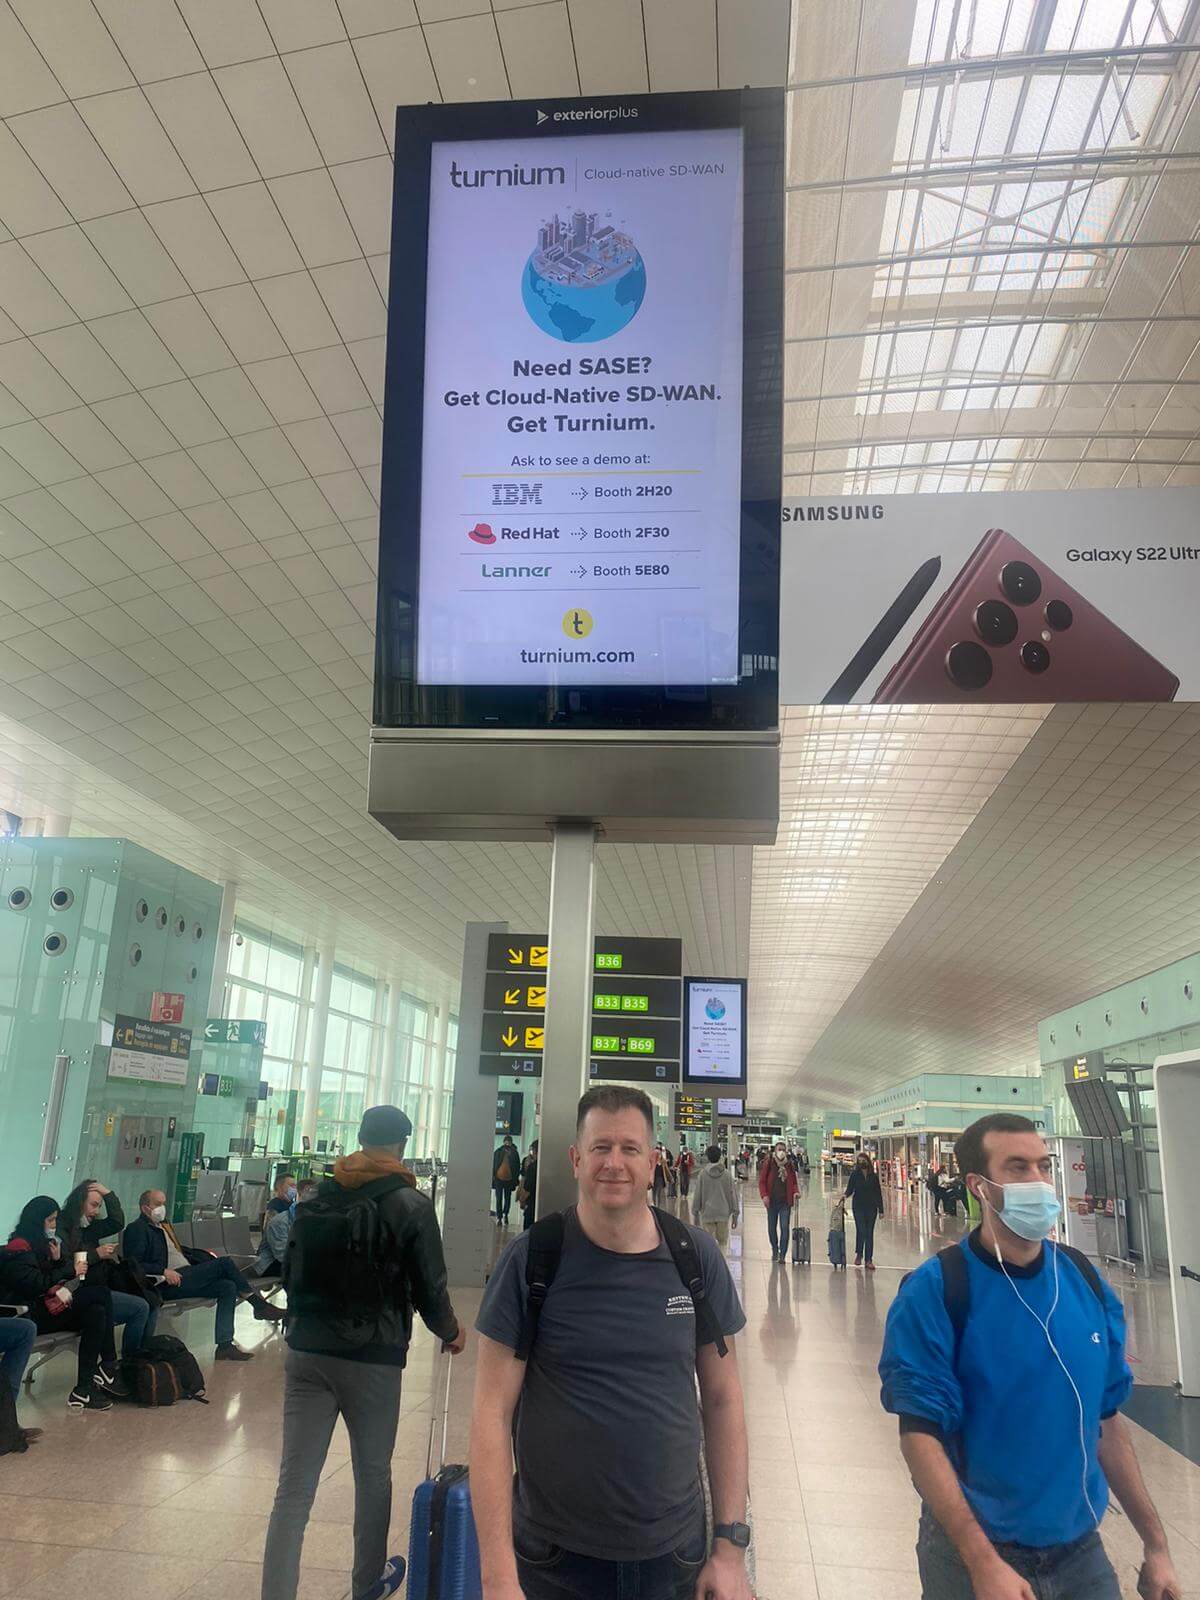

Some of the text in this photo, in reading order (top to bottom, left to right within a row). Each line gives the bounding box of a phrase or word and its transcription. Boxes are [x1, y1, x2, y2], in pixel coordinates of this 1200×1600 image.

[554, 107, 638, 121] exteriorplus
[450, 161, 565, 188] turnium
[585, 164, 724, 179] Cloud-native SD-WAN
[514, 356, 652, 377] Need SASE?
[444, 384, 721, 407] Get Cloud-Native SD-WAN.
[507, 413, 656, 433] Get Turnium.
[511, 454, 650, 466] Ask to see a demo at:
[492, 483, 672, 505] IBM Booth 2H20
[782, 504, 884, 522] SAMSUNG
[501, 527, 669, 540] Red Hat Booth 2F30
[1066, 548, 1132, 565] Galaxy
[1136, 546, 1167, 560] S22
[482, 564, 670, 577] Lanner Booth 5E80
[520, 648, 635, 664] turnium.com
[598, 956, 619, 966] B36
[597, 997, 645, 1009] B33 B35
[595, 1038, 652, 1051] B37 B69
